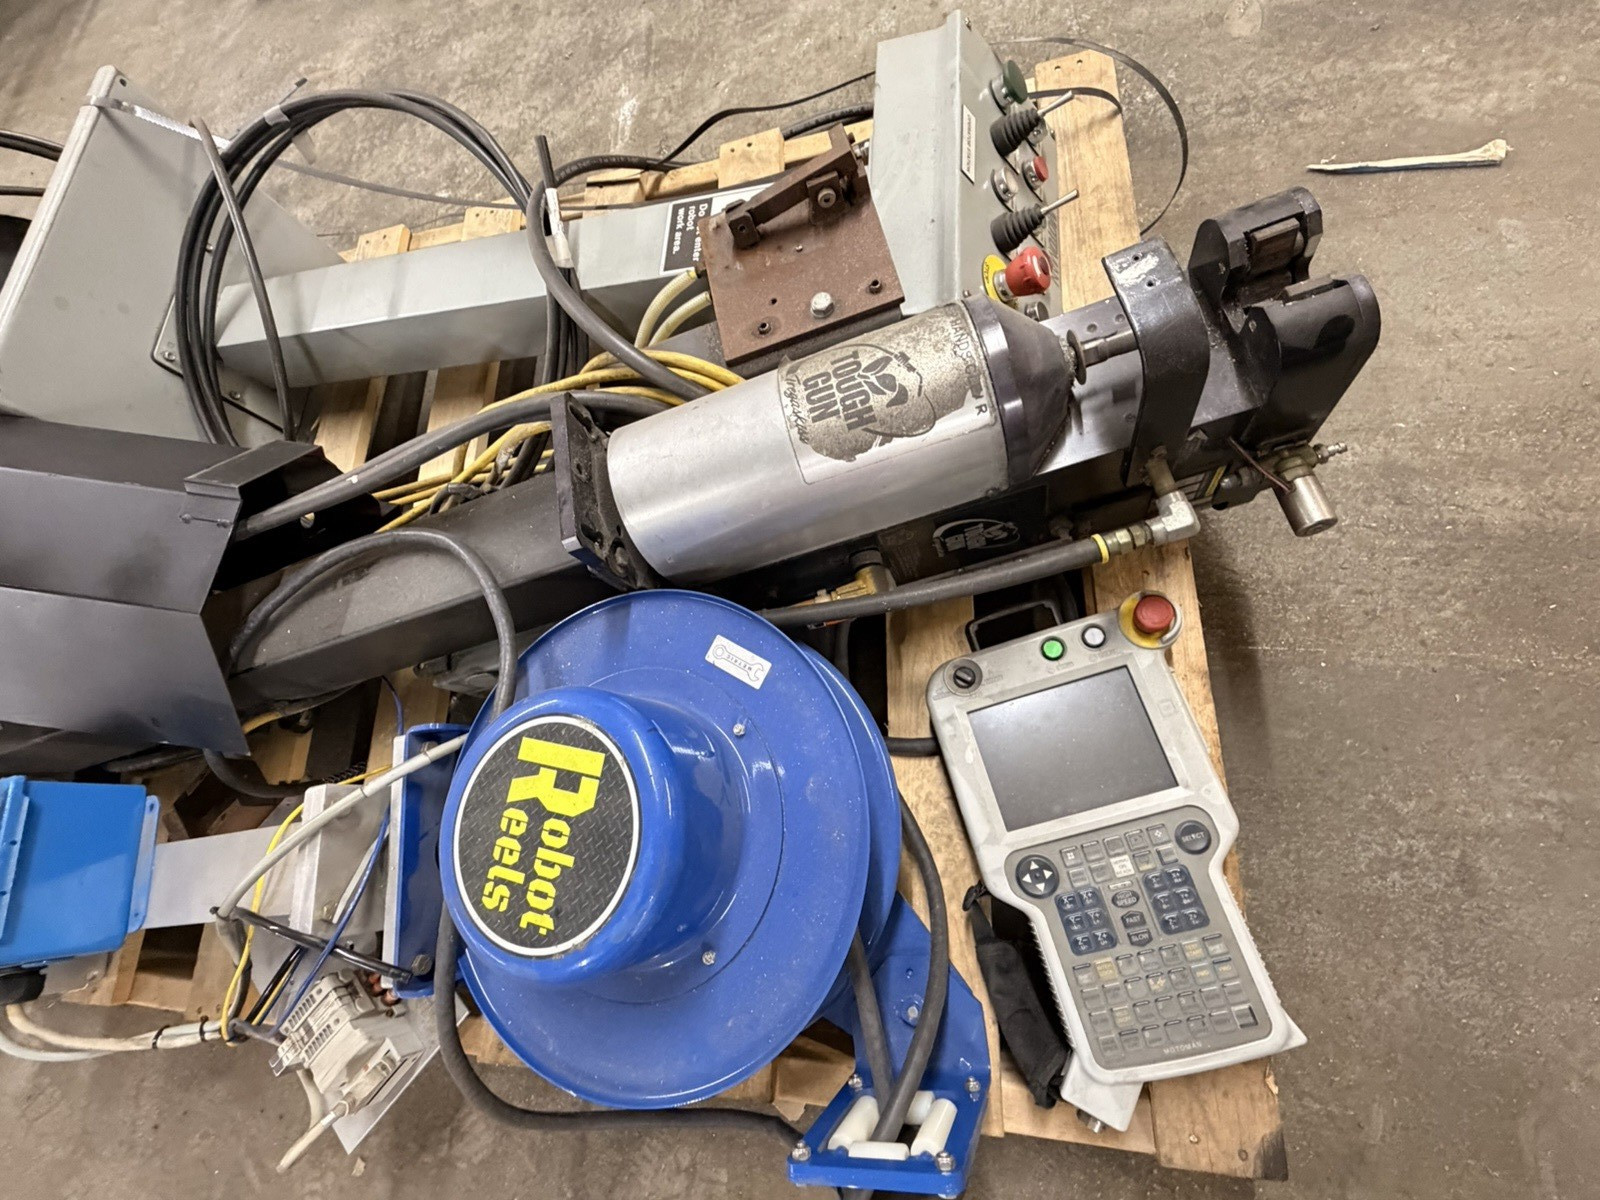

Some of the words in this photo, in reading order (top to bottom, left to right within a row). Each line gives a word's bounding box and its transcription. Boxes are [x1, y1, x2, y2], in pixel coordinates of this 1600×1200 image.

[675, 207, 686, 230] work
[686, 205, 697, 232] robot
[698, 202, 708, 217] Do
[672, 232, 683, 255] area.
[692, 236, 703, 262] enter
[801, 371, 842, 424] GUN
[830, 350, 878, 431] TOUGH
[506, 736, 606, 936] Robot
[1125, 915, 1141, 923] FAST
[1163, 1041, 1203, 1055] MOTOMAN
